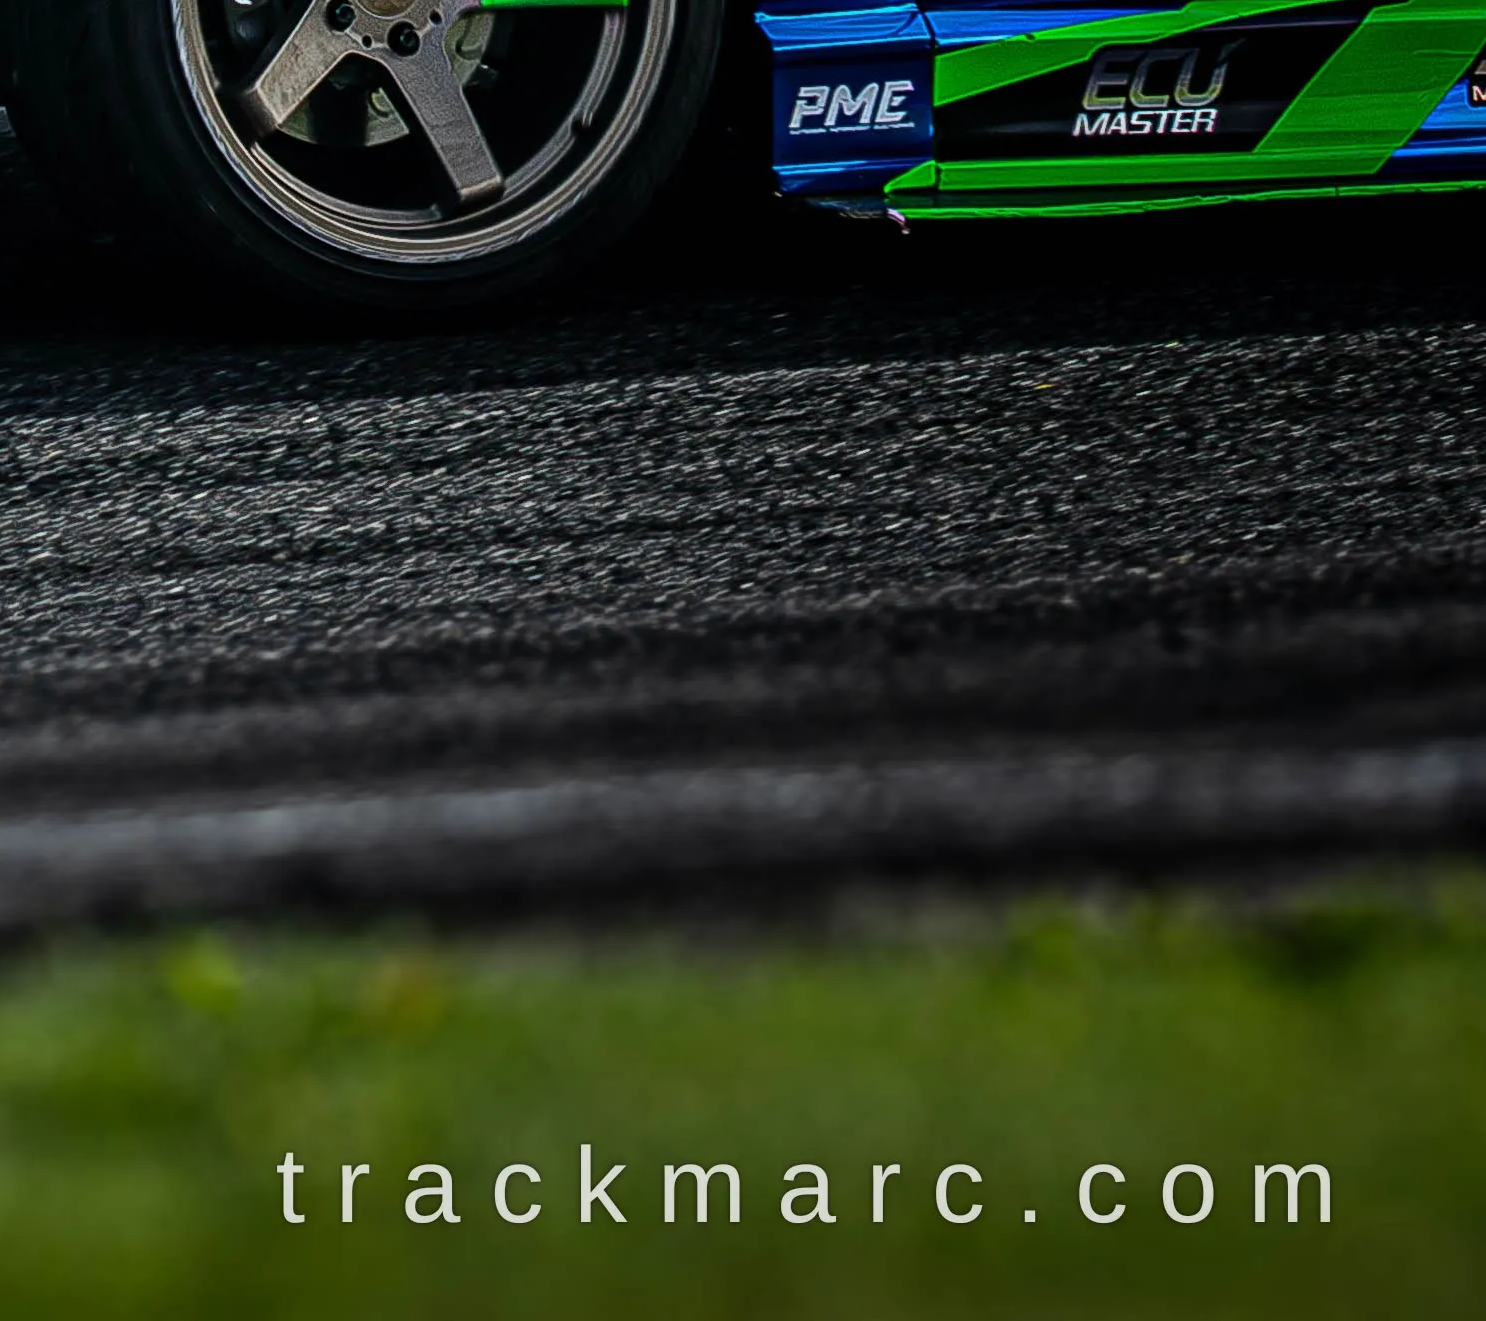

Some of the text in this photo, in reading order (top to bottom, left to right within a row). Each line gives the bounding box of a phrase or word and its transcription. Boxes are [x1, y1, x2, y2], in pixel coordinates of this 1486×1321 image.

[1082, 41, 1240, 111] ECU
[789, 80, 915, 128] PME
[1072, 108, 1218, 137] MASTER
